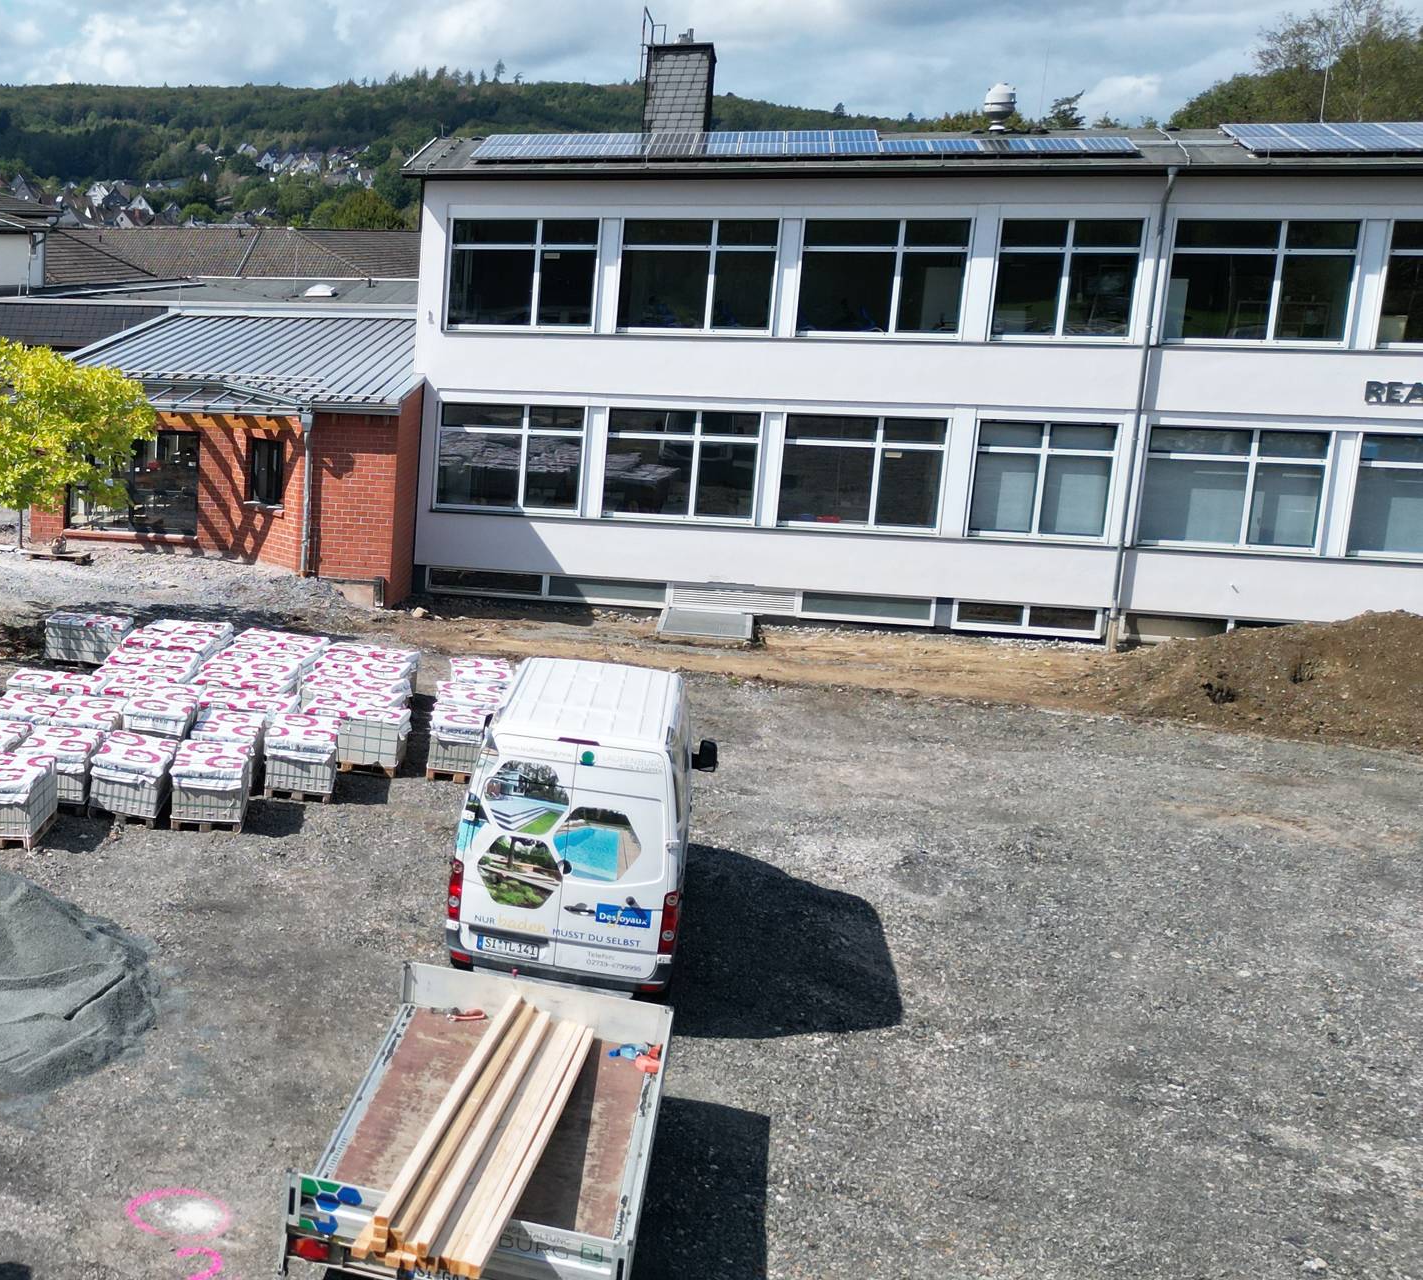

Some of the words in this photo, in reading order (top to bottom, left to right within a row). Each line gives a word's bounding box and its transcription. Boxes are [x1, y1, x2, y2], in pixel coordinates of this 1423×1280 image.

[474, 914, 495, 924] NUR
[497, 914, 545, 932] baden
[552, 928, 584, 940] MUSST
[588, 933, 603, 943] DU
[607, 936, 641, 947] SELBST
[485, 938, 496, 949] SI
[503, 942, 515, 952] TL
[517, 944, 536, 956] 141
